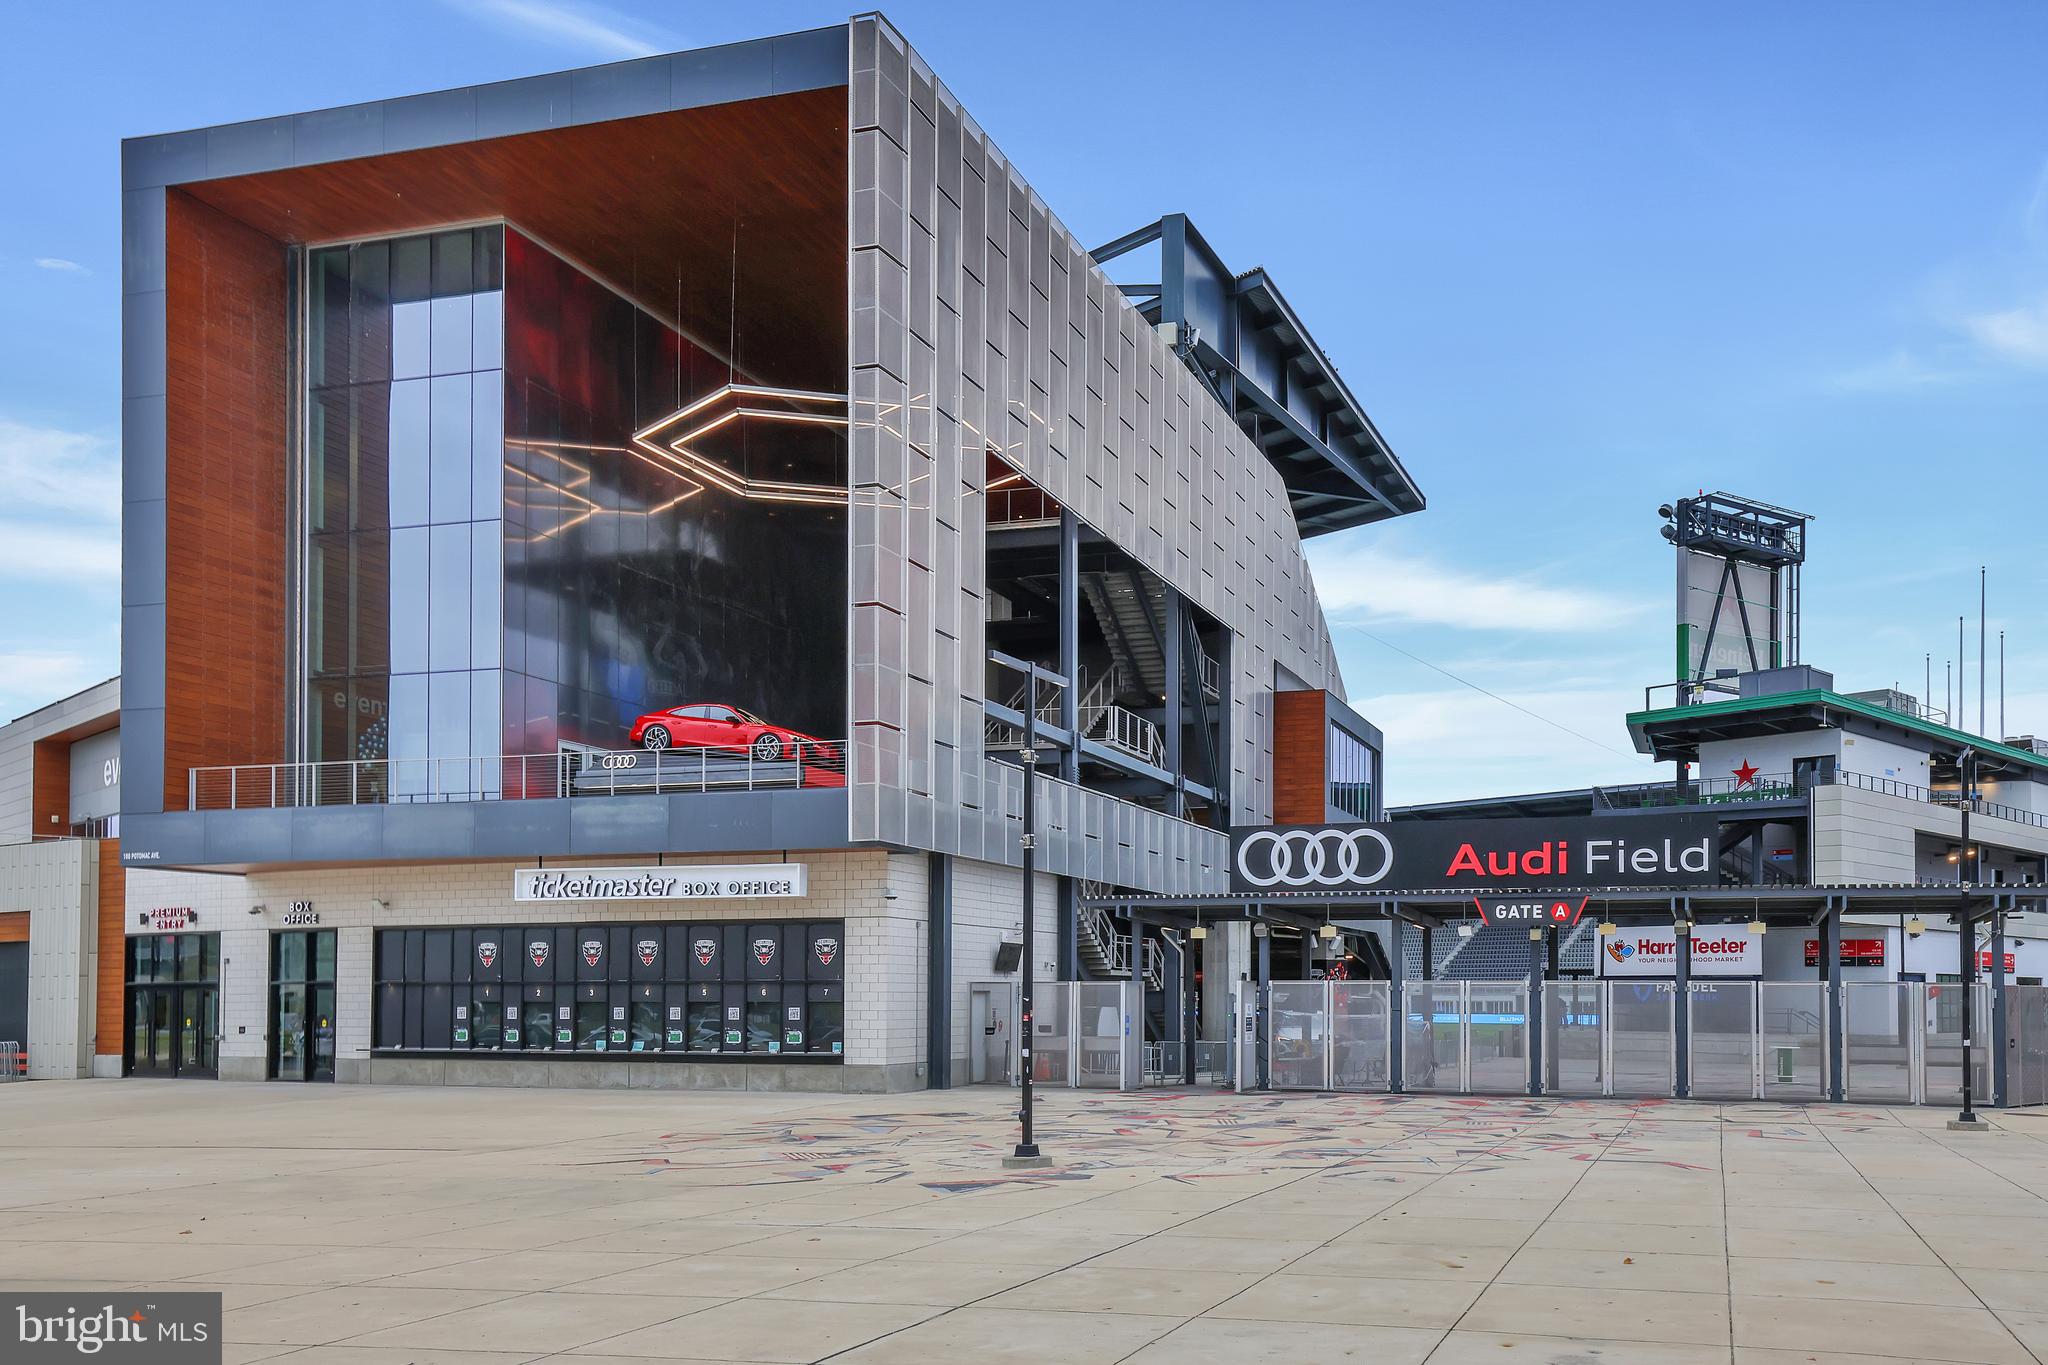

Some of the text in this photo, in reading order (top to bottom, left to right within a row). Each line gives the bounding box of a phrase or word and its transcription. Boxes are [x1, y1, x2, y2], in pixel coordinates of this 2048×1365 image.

[131, 851, 150, 860] POTOMAC
[1446, 838, 1709, 876] Audi Field
[528, 873, 791, 898] ticketmaster BOX OFFICE
[149, 907, 190, 918] PREMIUM
[289, 902, 312, 913] BOX
[1495, 904, 1566, 919] GATE A
[156, 919, 185, 929] ENTRY
[282, 913, 318, 925] OFFICE
[1690, 937, 1747, 954] Teeter
